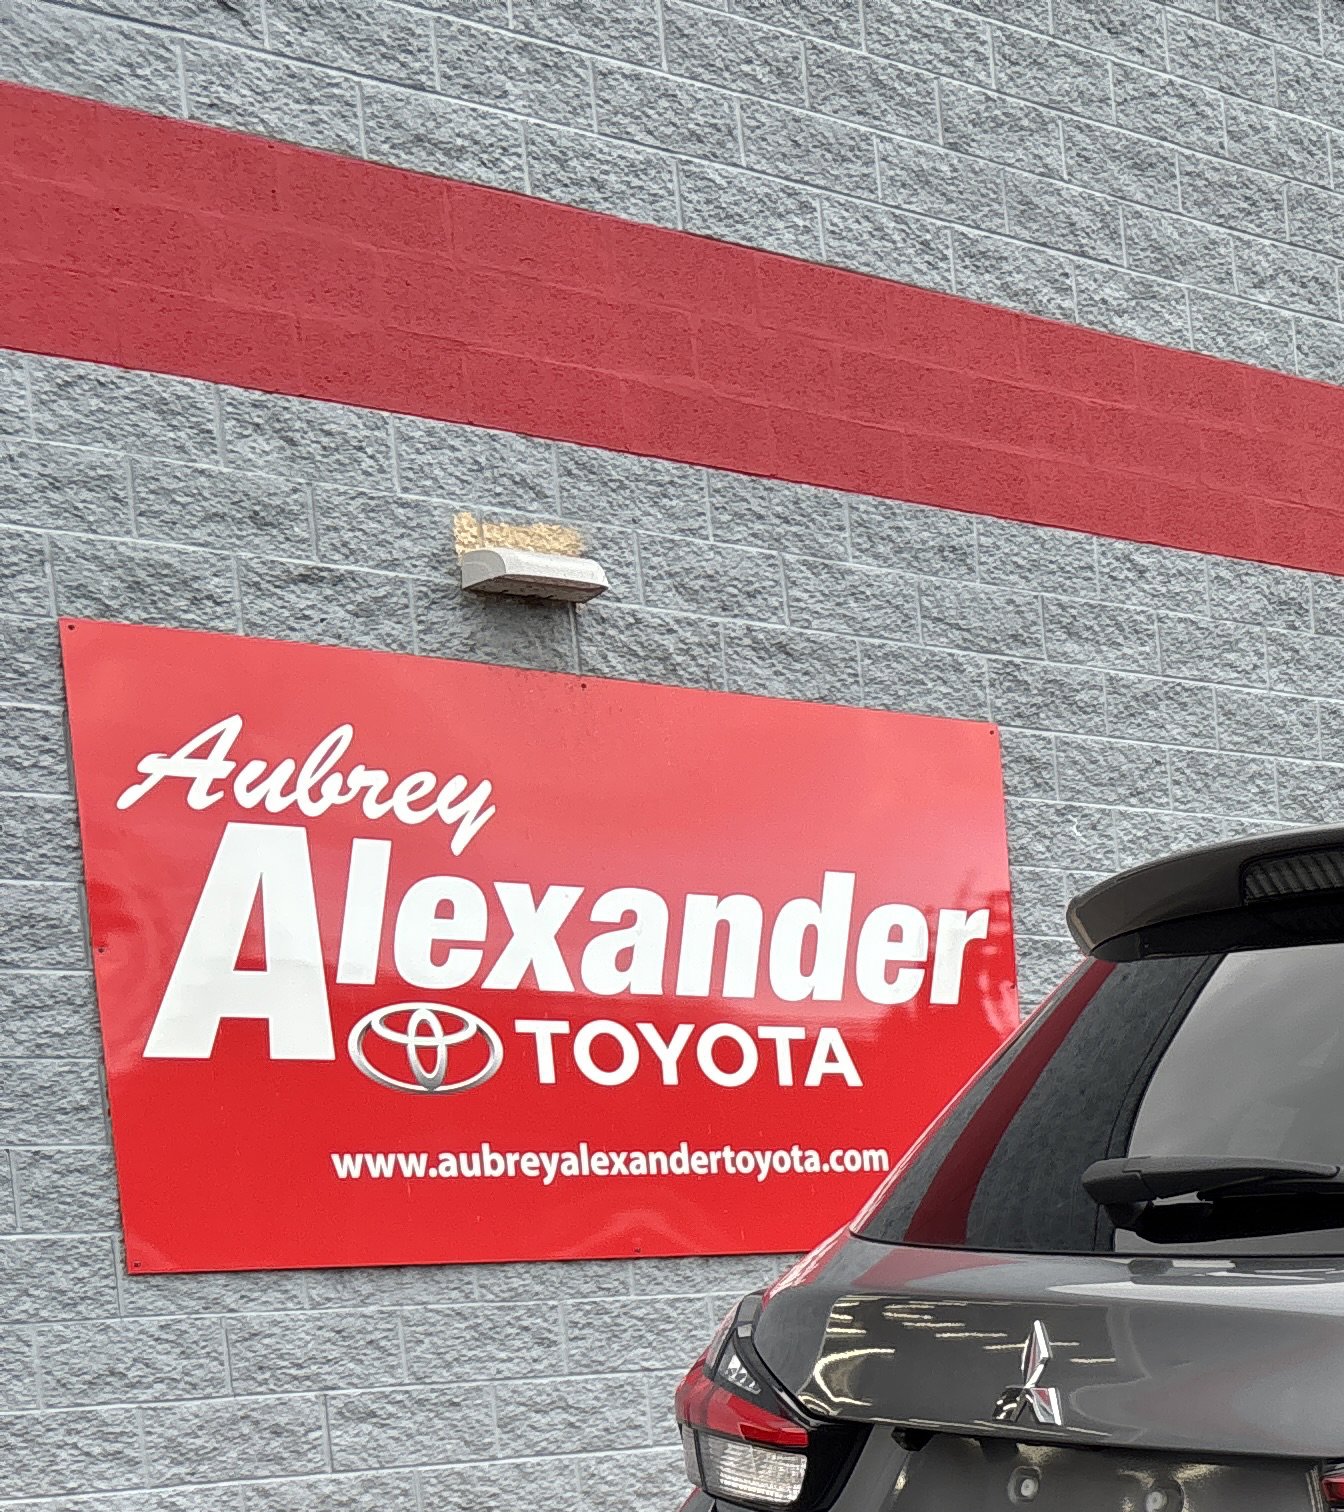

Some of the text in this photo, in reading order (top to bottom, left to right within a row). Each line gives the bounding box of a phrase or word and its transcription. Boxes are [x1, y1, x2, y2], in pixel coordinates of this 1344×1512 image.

[117, 713, 496, 857] Aubrey
[144, 821, 988, 1061] Alexander
[516, 1018, 863, 1087] TOYOTA
[331, 1142, 890, 1186] www.aubreyalexandertoyota.com
